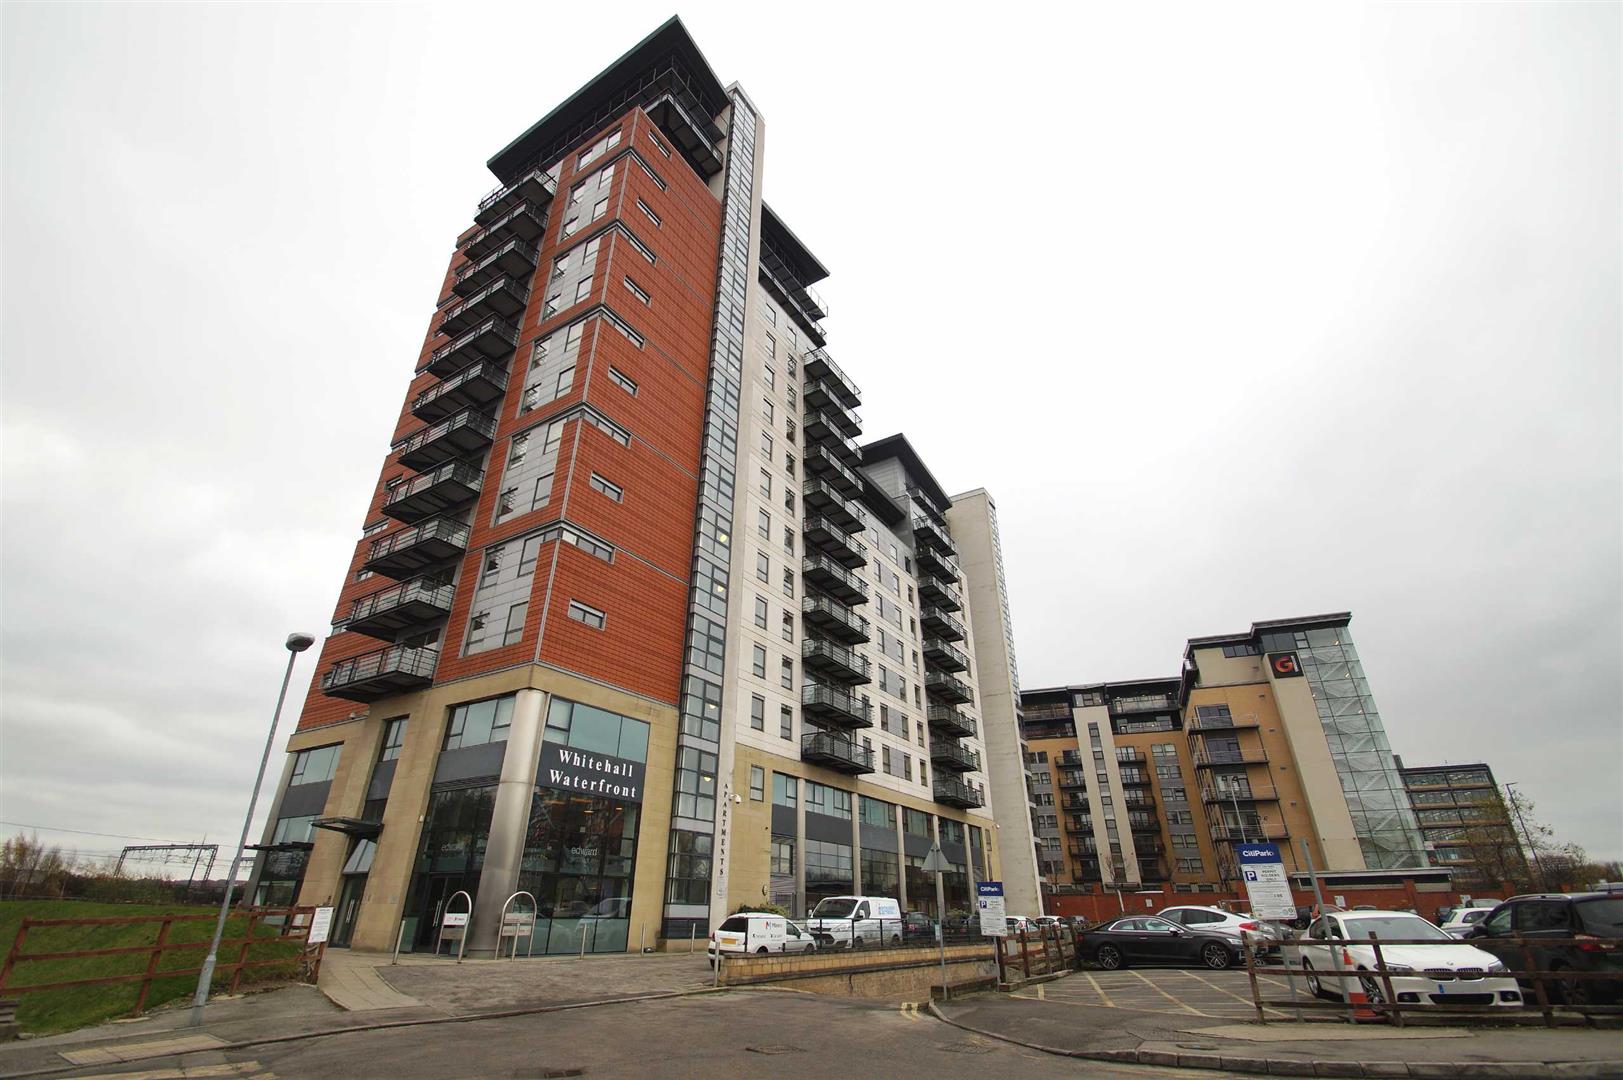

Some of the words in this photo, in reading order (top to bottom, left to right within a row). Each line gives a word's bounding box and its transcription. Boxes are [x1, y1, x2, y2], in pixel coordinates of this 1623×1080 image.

[559, 749, 633, 777] Whitehall
[550, 769, 636, 798] Waterfront
[719, 783, 729, 876] APARTMENTS
